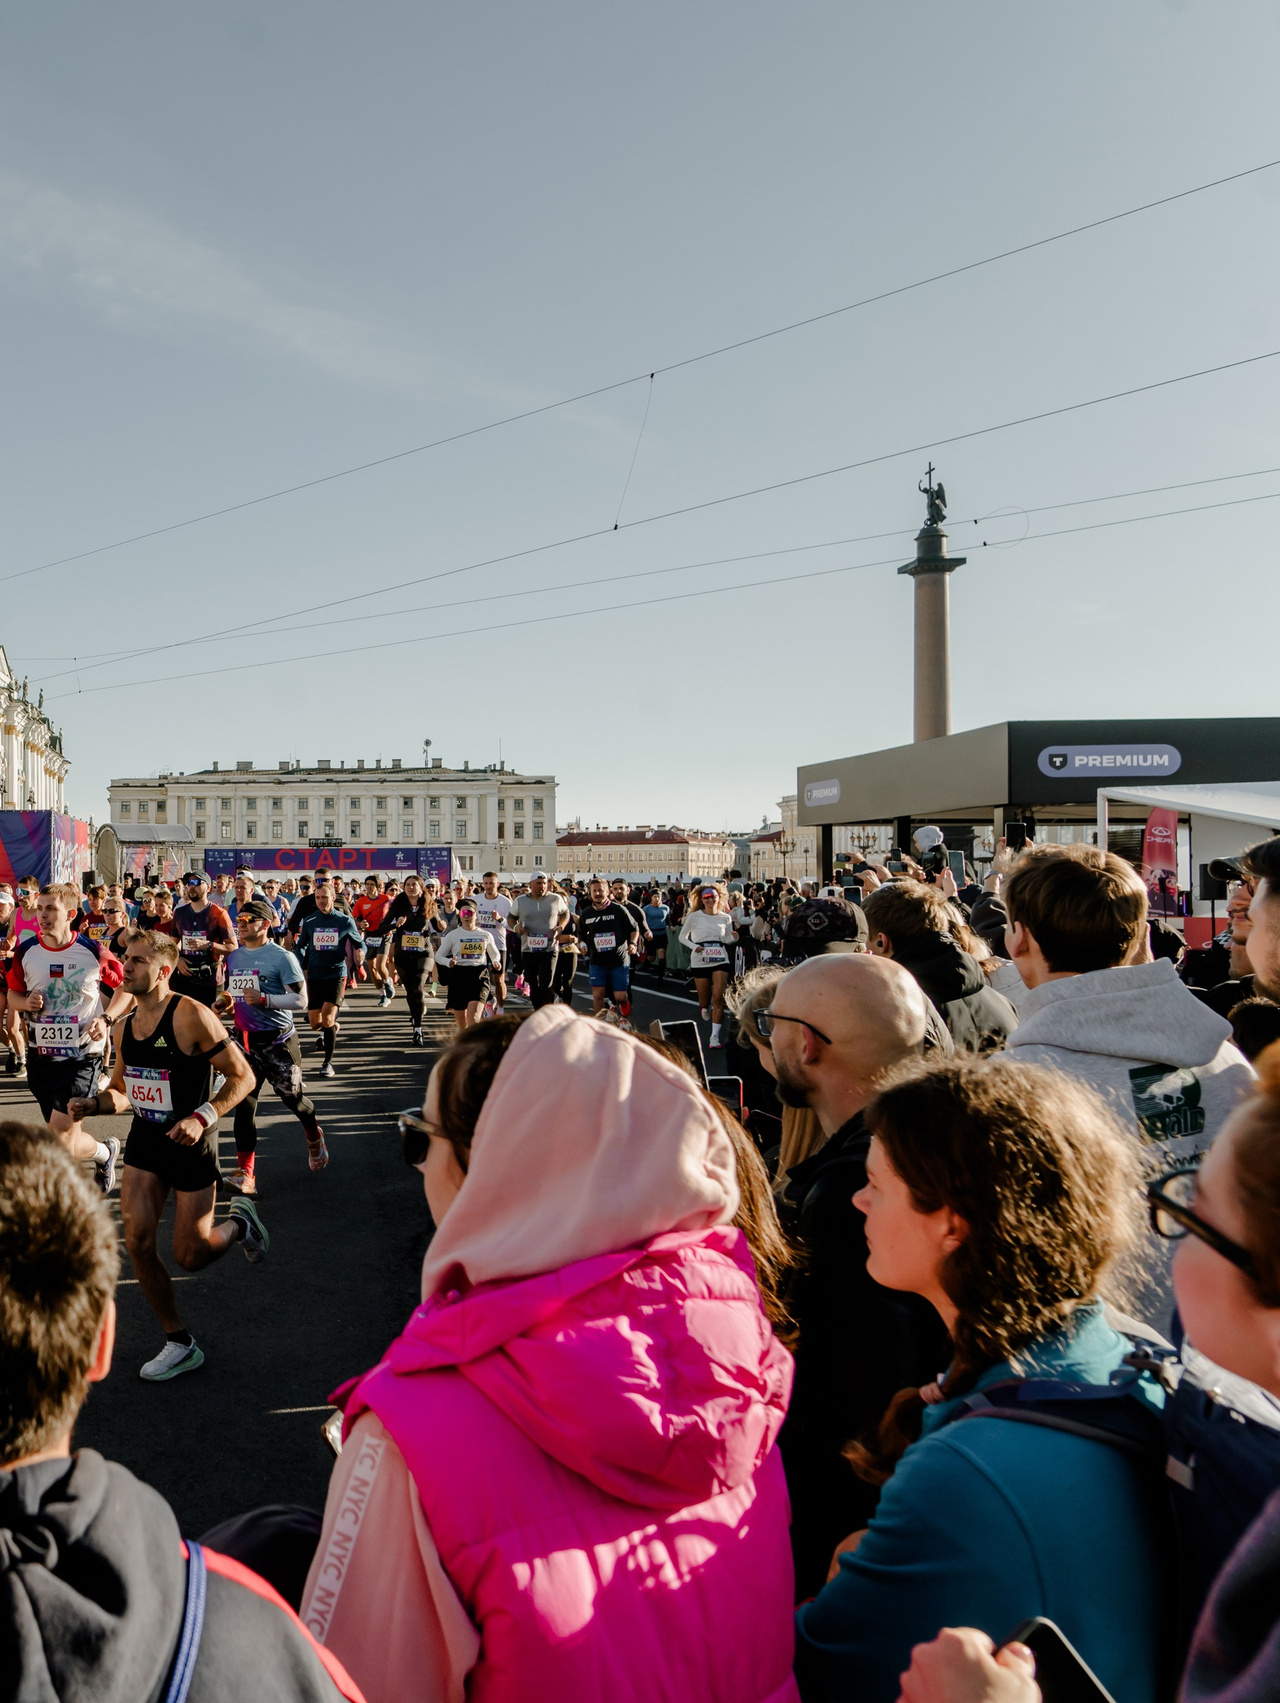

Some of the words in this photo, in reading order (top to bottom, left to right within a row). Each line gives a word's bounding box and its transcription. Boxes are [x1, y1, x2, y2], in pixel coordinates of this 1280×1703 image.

[1074, 754, 1169, 767] PREMIUM
[813, 786, 838, 799] PREMIUM
[274, 848, 378, 870] СТАРТ
[316, 935, 336, 943] 6620
[406, 936, 419, 944] 253
[463, 943, 483, 951] 4866
[232, 978, 255, 990] 3223
[41, 1027, 73, 1040] 2312
[132, 1084, 163, 1104] 6541
[340, 1475, 371, 1526] NYC
[322, 1531, 354, 1582] NYC
[305, 1585, 337, 1638] NYC
